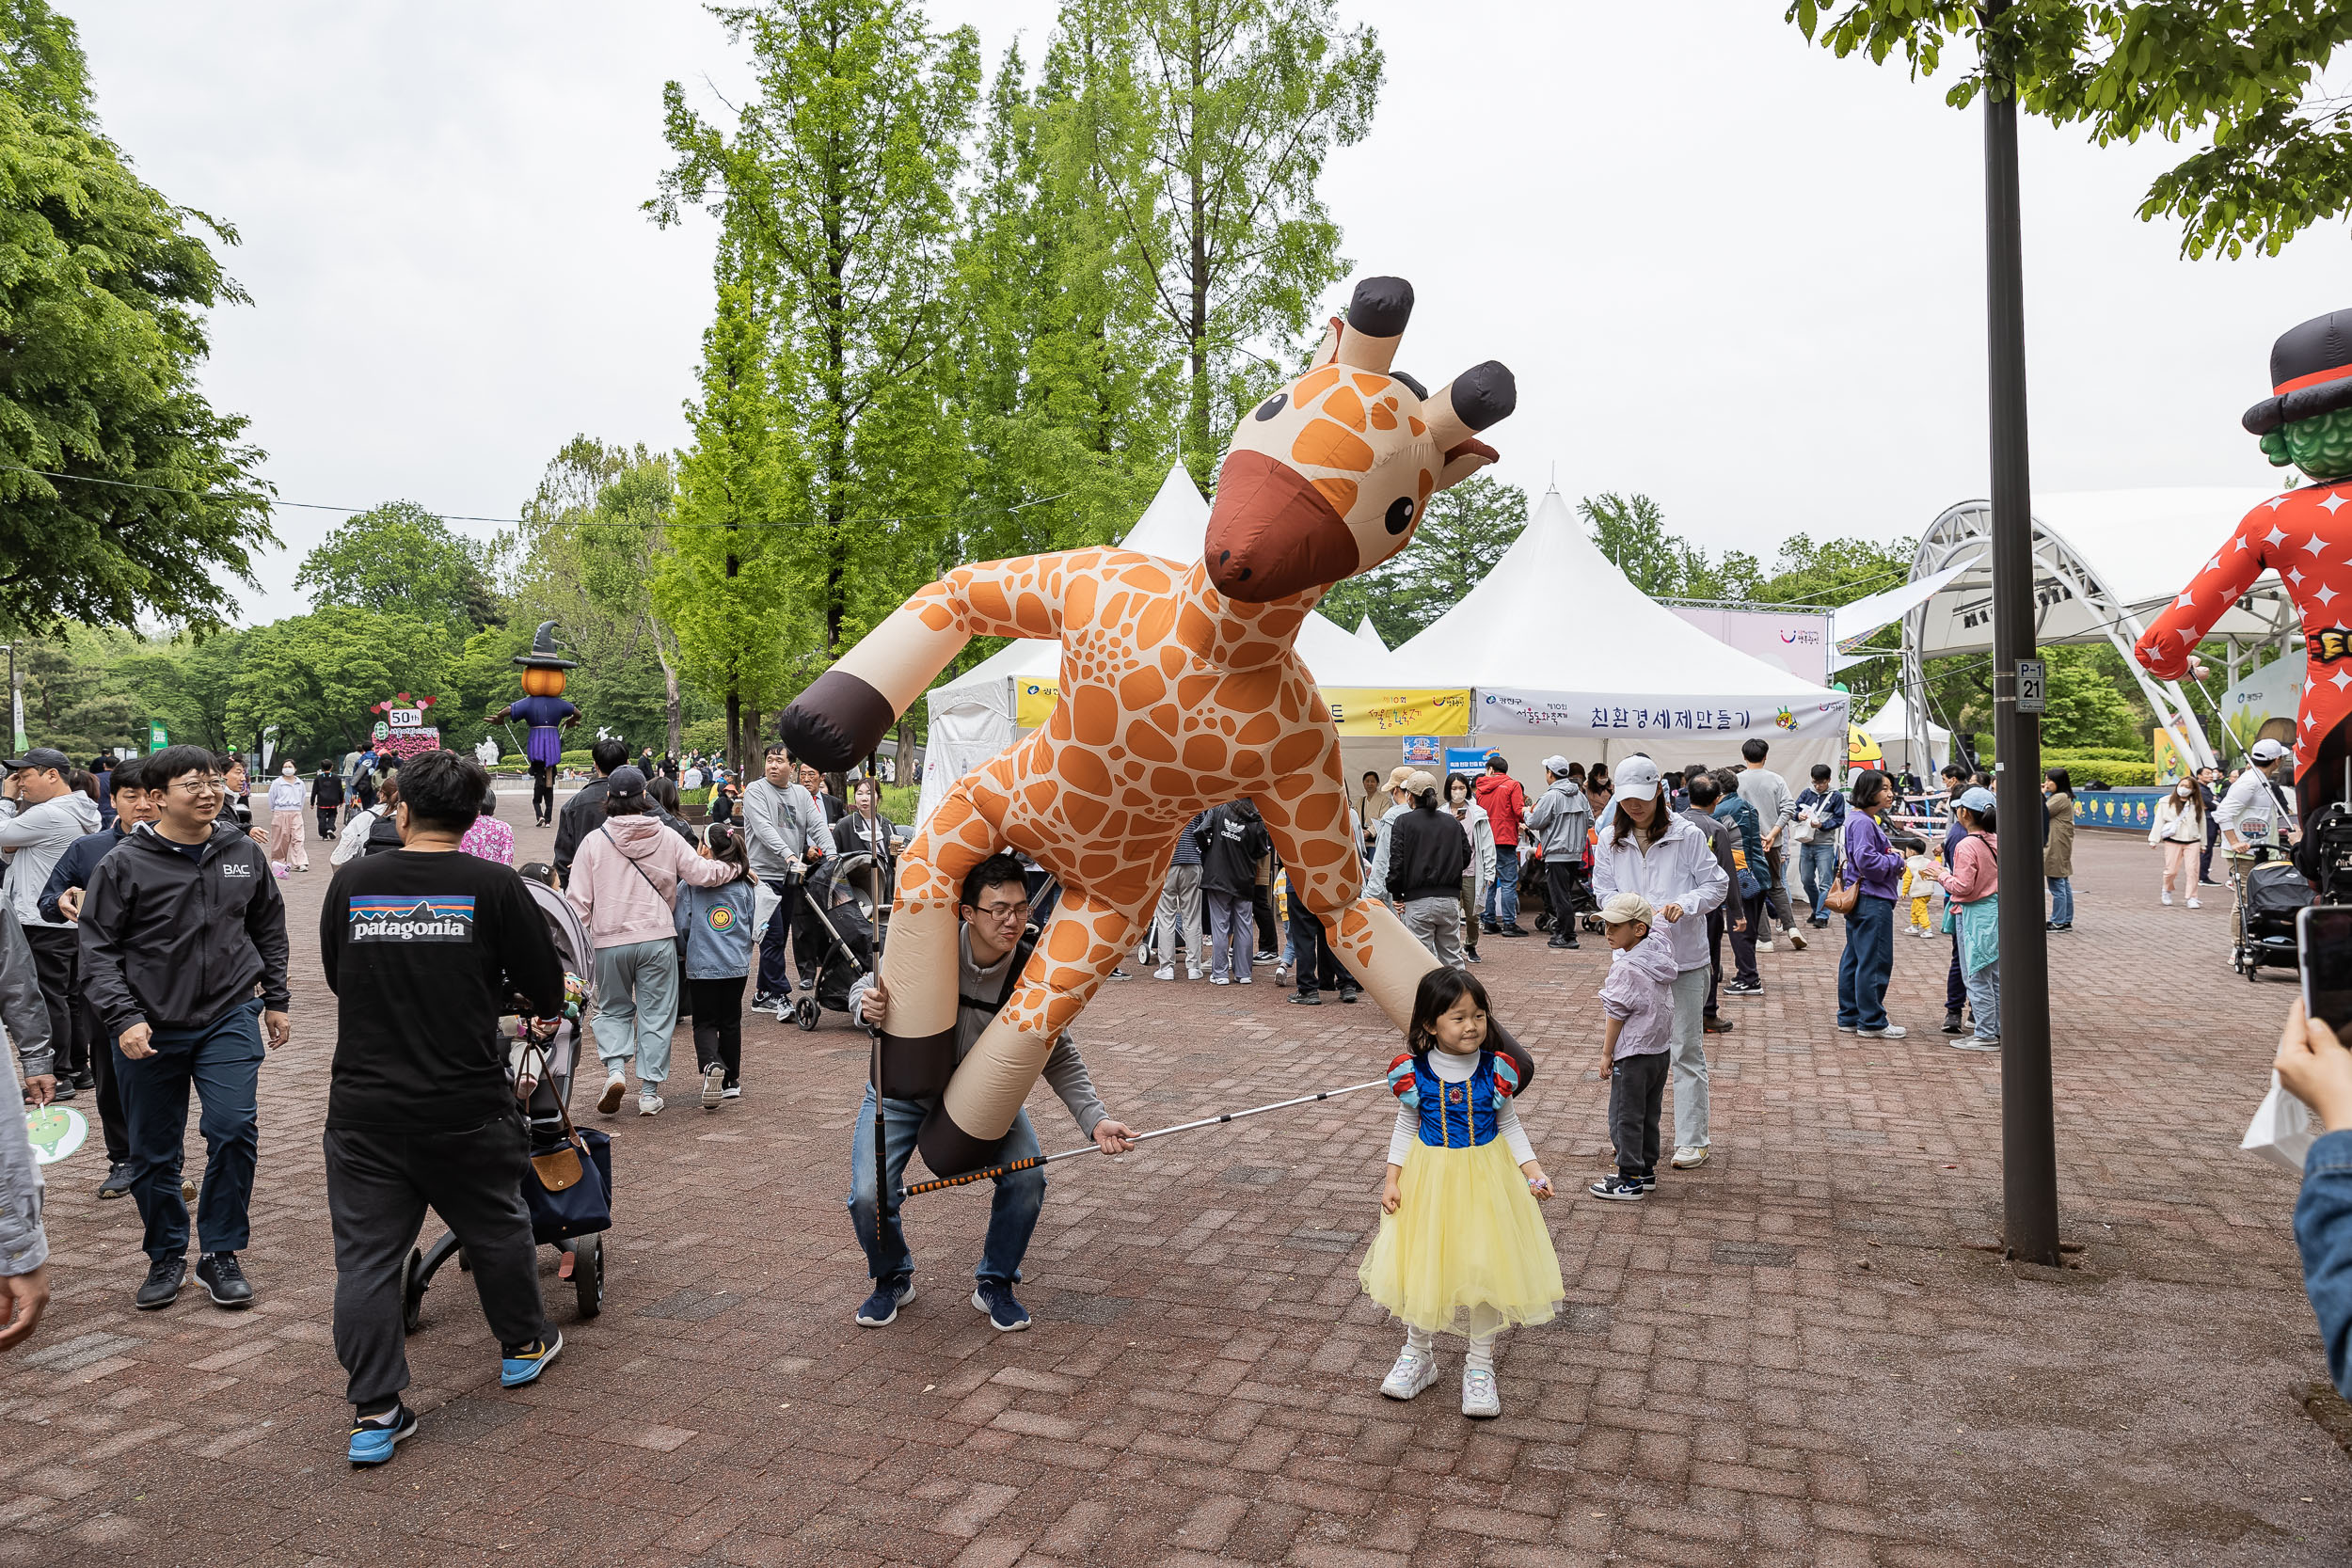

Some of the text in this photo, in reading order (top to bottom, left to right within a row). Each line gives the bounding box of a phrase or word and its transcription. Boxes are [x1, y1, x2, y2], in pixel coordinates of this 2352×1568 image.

[2021, 664, 2042, 677] P-1
[2023, 679, 2041, 698] 21
[391, 711, 420, 724] 50th
[1517, 707, 1568, 726] 서울동화축제
[1591, 706, 1751, 729] 친환경세제만들기
[1220, 831, 1242, 842] adidas
[222, 863, 251, 875] BAC
[354, 919, 466, 940] patagonia
